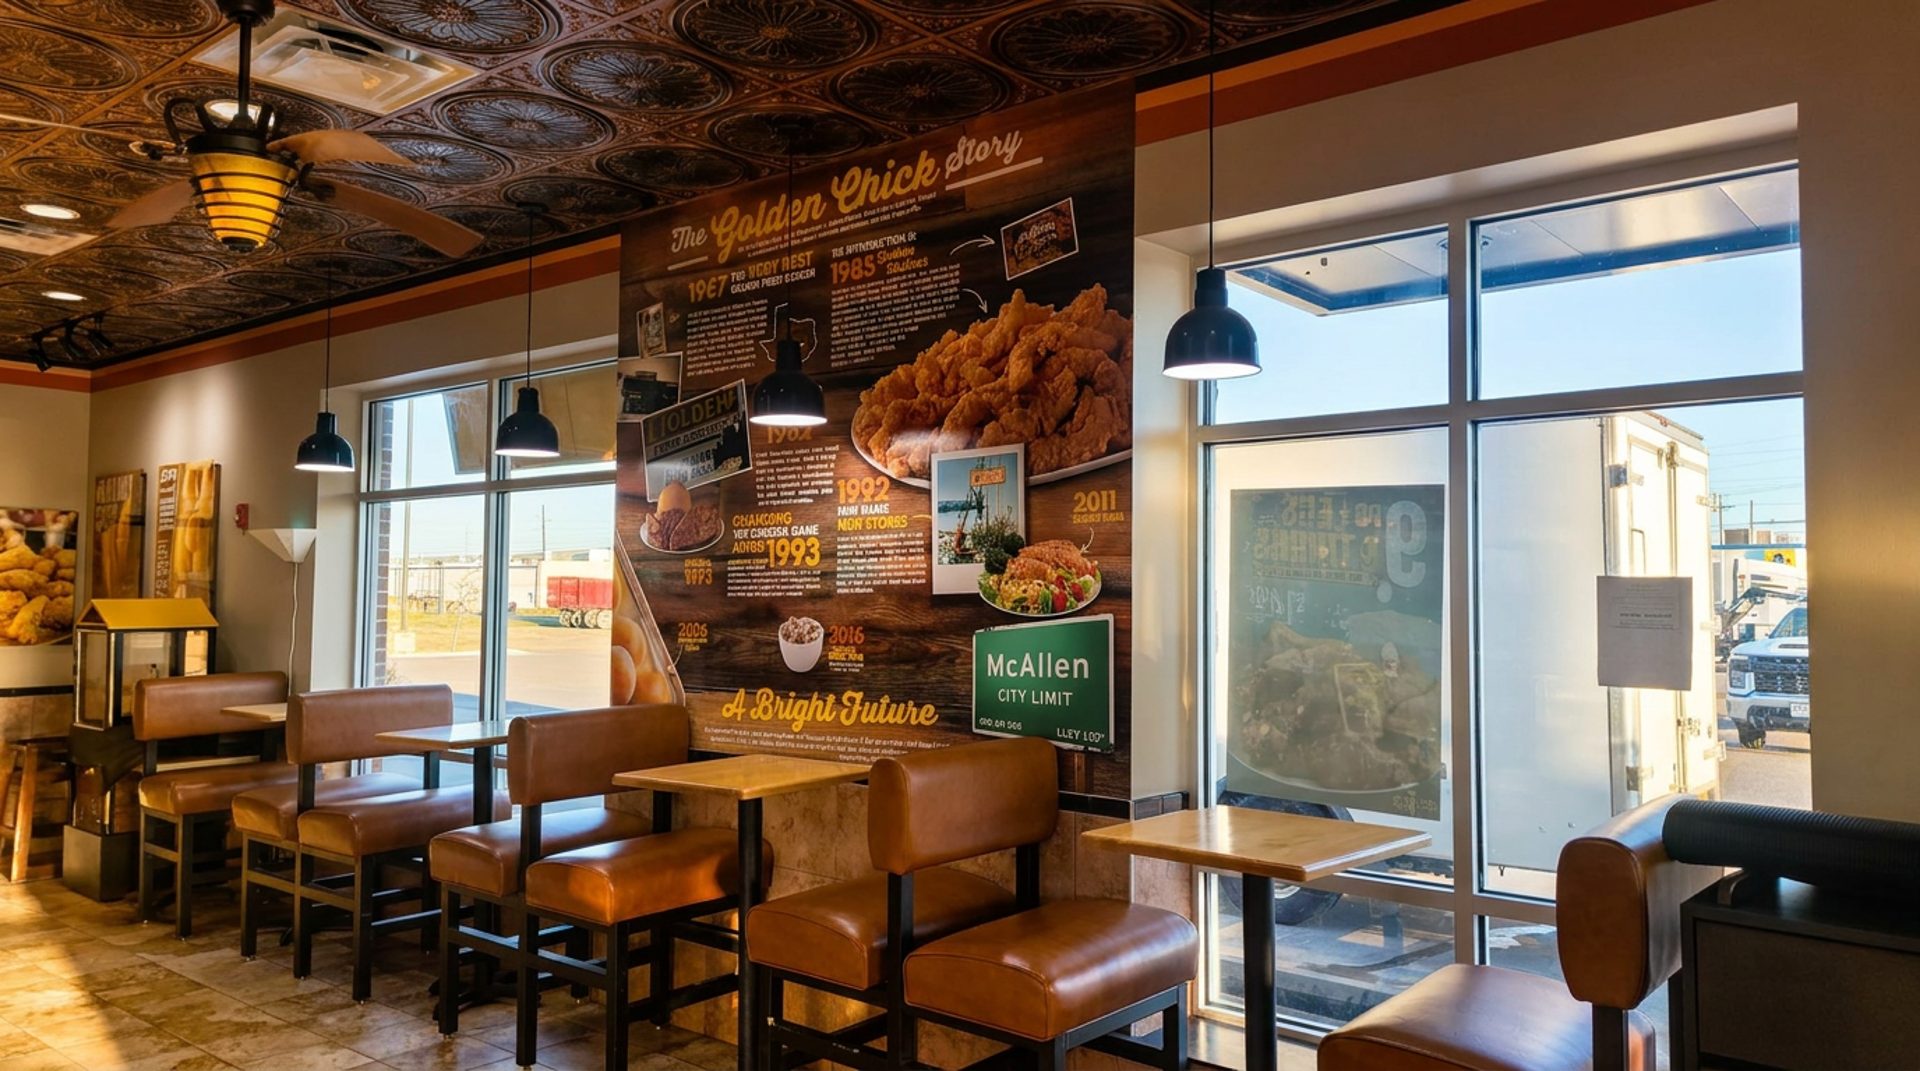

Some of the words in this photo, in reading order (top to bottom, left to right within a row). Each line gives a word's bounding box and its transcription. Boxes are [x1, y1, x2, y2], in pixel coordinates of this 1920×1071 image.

[672, 225, 707, 252] The
[711, 193, 826, 263] Golden
[831, 150, 940, 214] Chick
[945, 131, 1023, 179] Story
[837, 476, 890, 503] 1992
[1073, 490, 1116, 512] 2011
[767, 537, 821, 568] 1993
[987, 652, 1089, 679] McAllen
[722, 688, 746, 722] A
[751, 687, 836, 732] Bright
[840, 689, 938, 726] Future
[998, 688, 1027, 703] CITY
[1031, 690, 1073, 706] LIMIT
